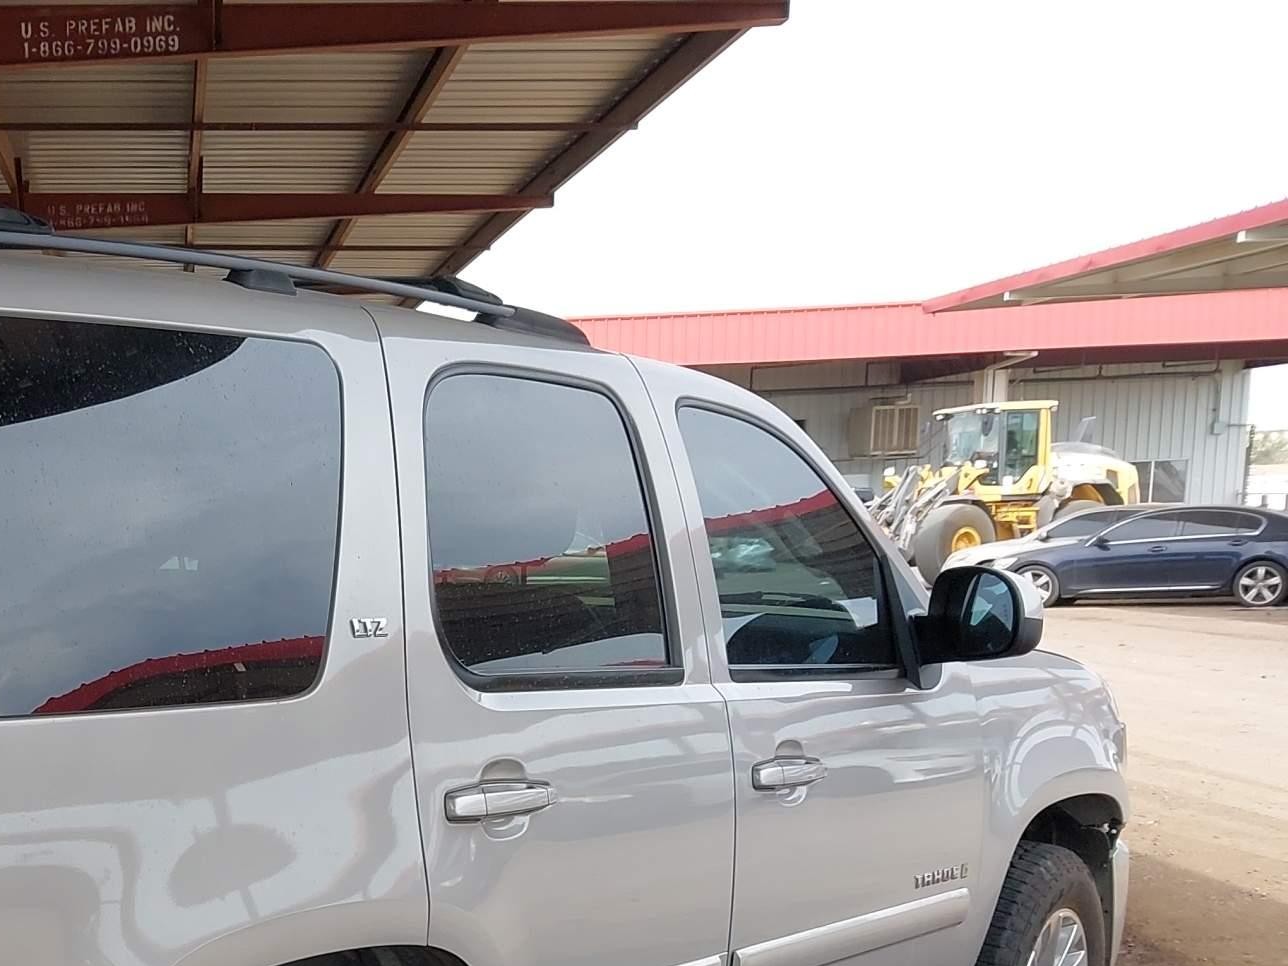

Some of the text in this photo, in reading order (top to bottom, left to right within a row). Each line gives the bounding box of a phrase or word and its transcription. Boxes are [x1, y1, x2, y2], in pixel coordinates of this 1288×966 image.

[20, 15, 181, 39] U.S. PREFAB INC.
[23, 35, 179, 59] 1-866-799-0969
[349, 617, 388, 639] LTZ
[913, 866, 959, 889] TAHOE
